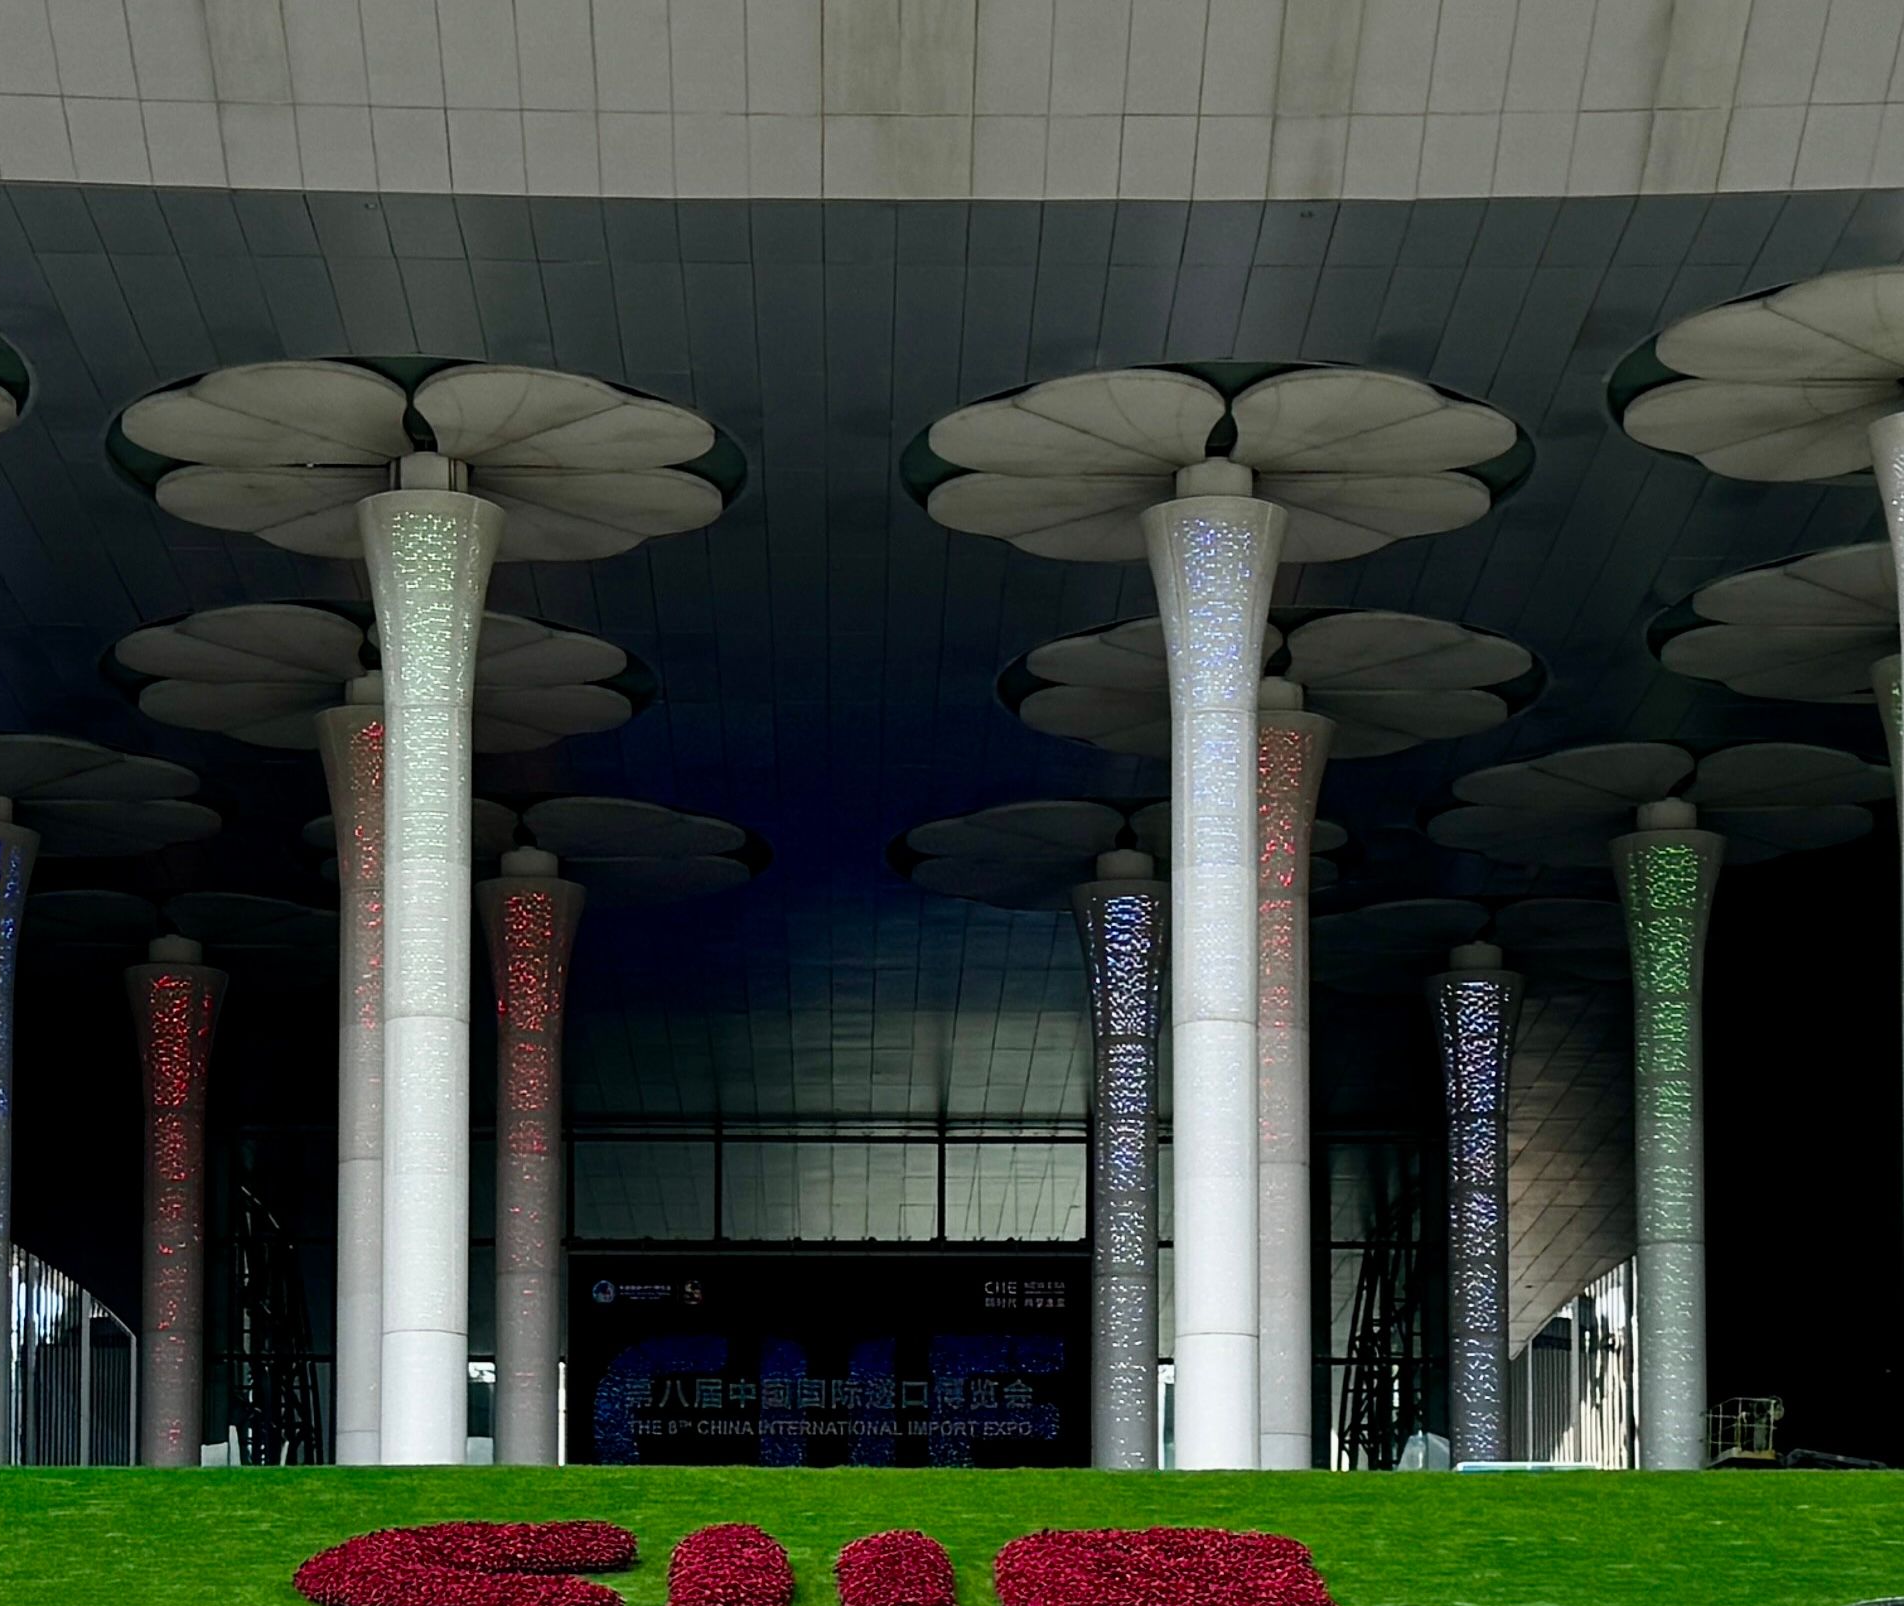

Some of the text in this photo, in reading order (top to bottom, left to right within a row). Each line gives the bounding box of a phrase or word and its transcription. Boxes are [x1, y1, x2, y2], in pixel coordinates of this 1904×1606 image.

[984, 1281, 1017, 1295] CIIE
[629, 1419, 663, 1435] THE
[697, 1419, 755, 1435] CHINA
[757, 1419, 903, 1435] INTERNATIONAL
[908, 1419, 978, 1435] IMPORT
[983, 1419, 1033, 1435] EXPO
